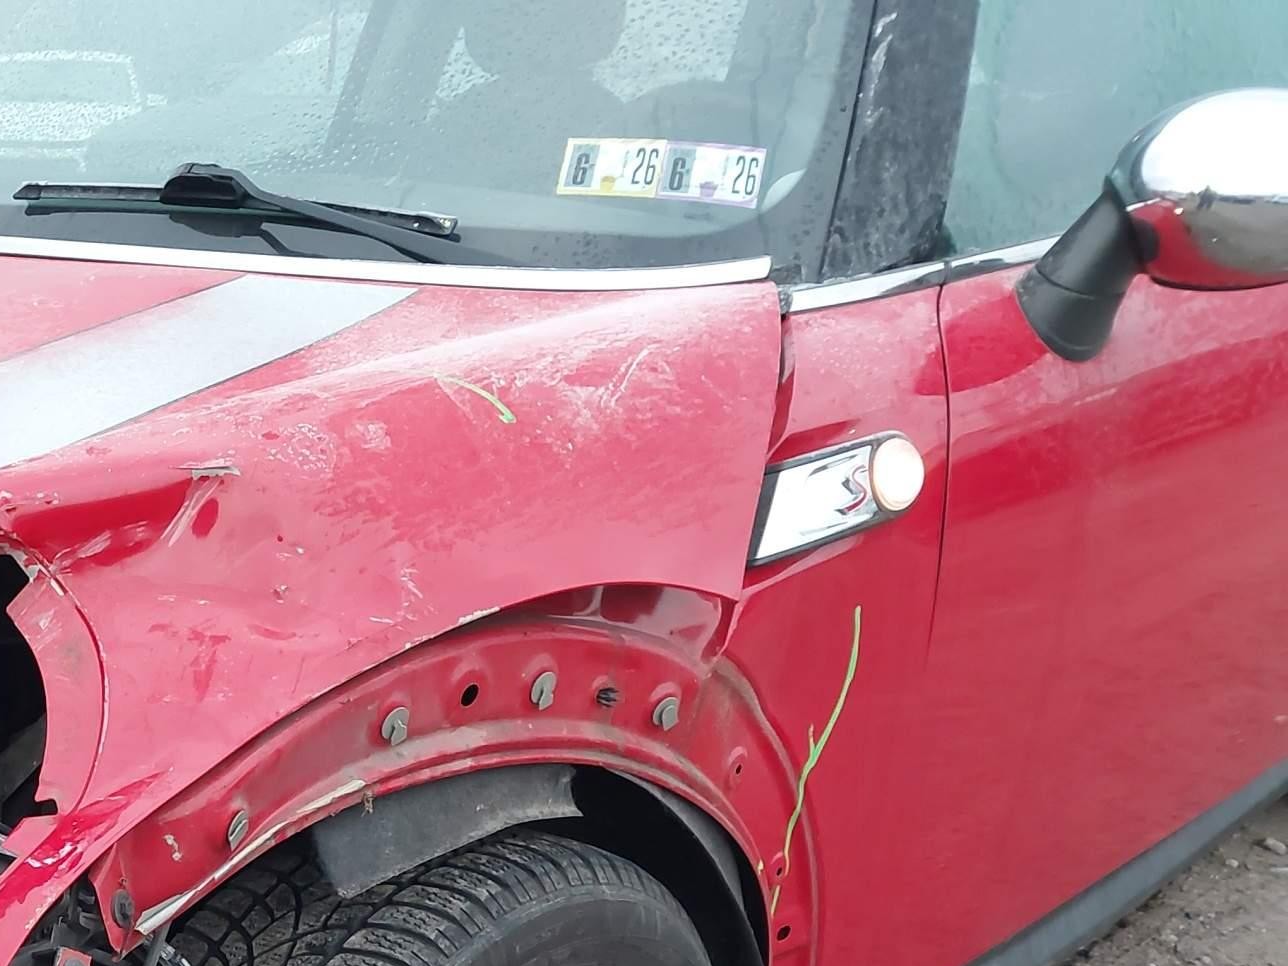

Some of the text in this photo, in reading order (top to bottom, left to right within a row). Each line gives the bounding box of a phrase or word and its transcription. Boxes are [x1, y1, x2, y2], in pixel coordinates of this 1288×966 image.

[572, 152, 590, 186] 6
[631, 147, 659, 185] 26
[669, 157, 686, 190] 6
[732, 155, 758, 195] 26
